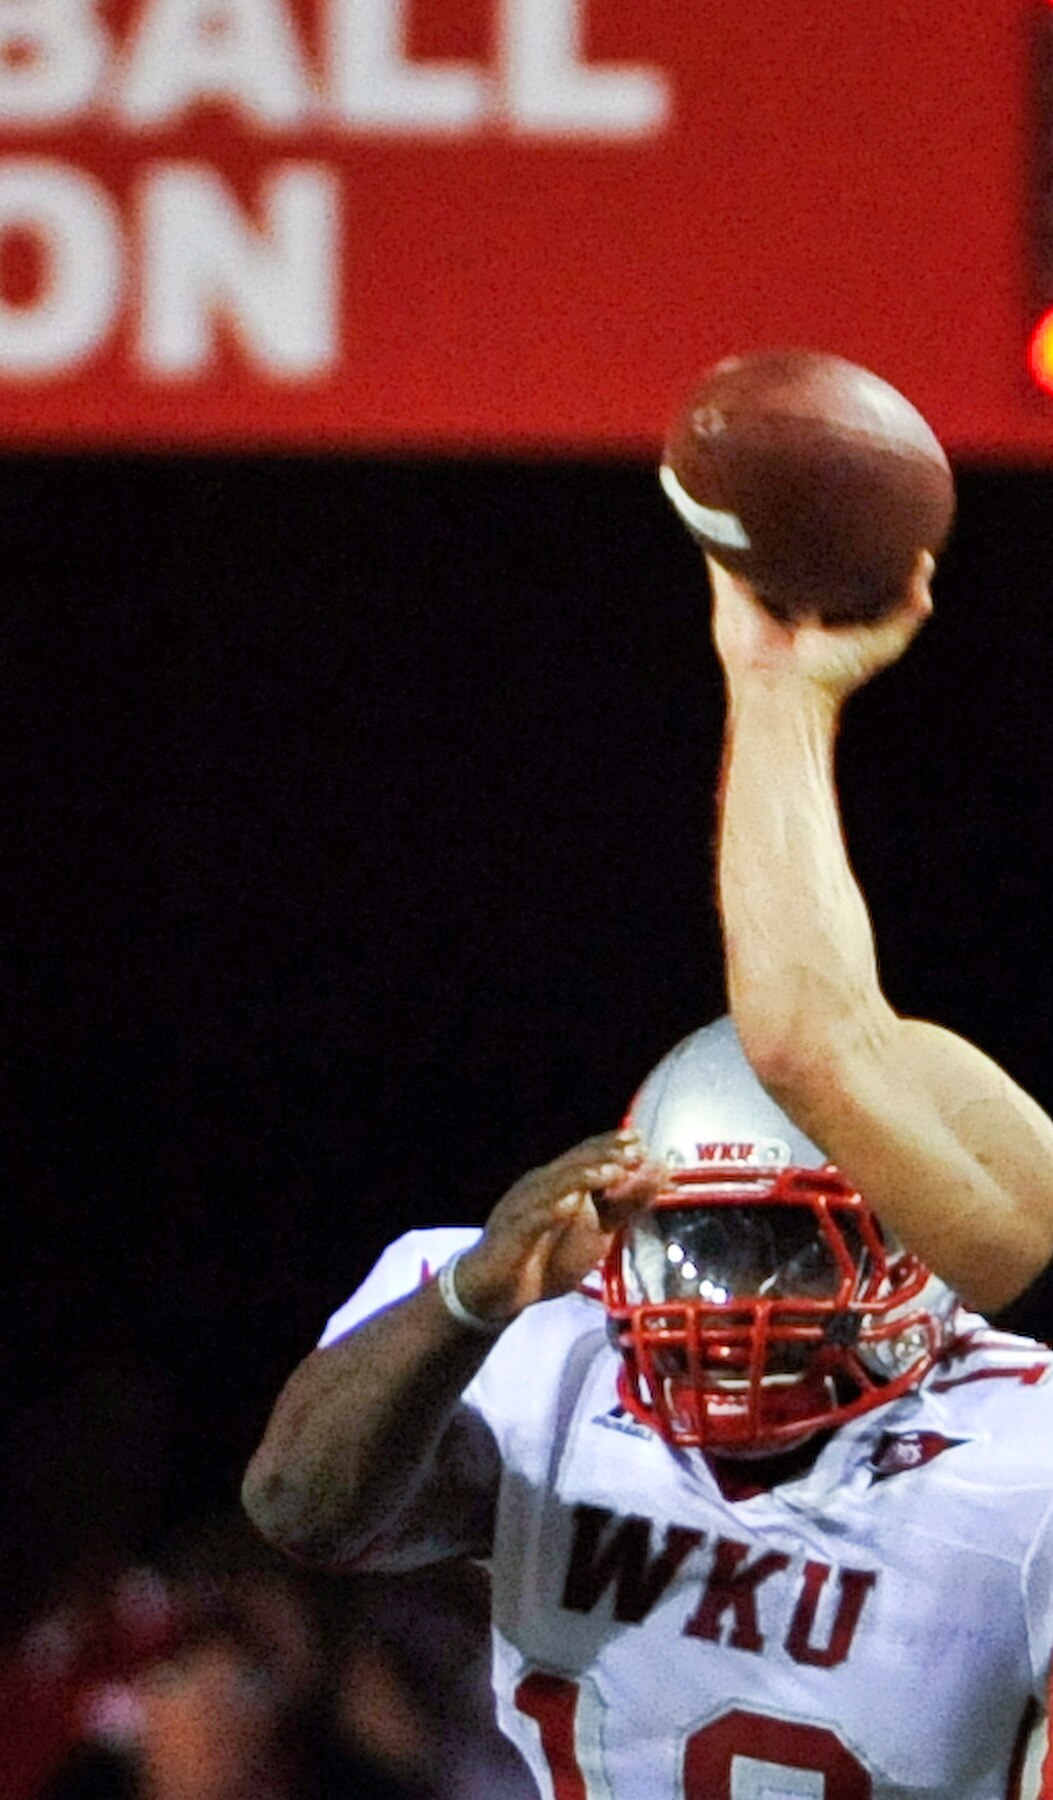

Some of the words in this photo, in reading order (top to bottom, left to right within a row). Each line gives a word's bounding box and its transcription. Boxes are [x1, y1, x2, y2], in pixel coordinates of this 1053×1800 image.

[0, 155, 342, 383] ON
[696, 1142, 754, 1161] WKU
[561, 1503, 877, 1669] WKU
